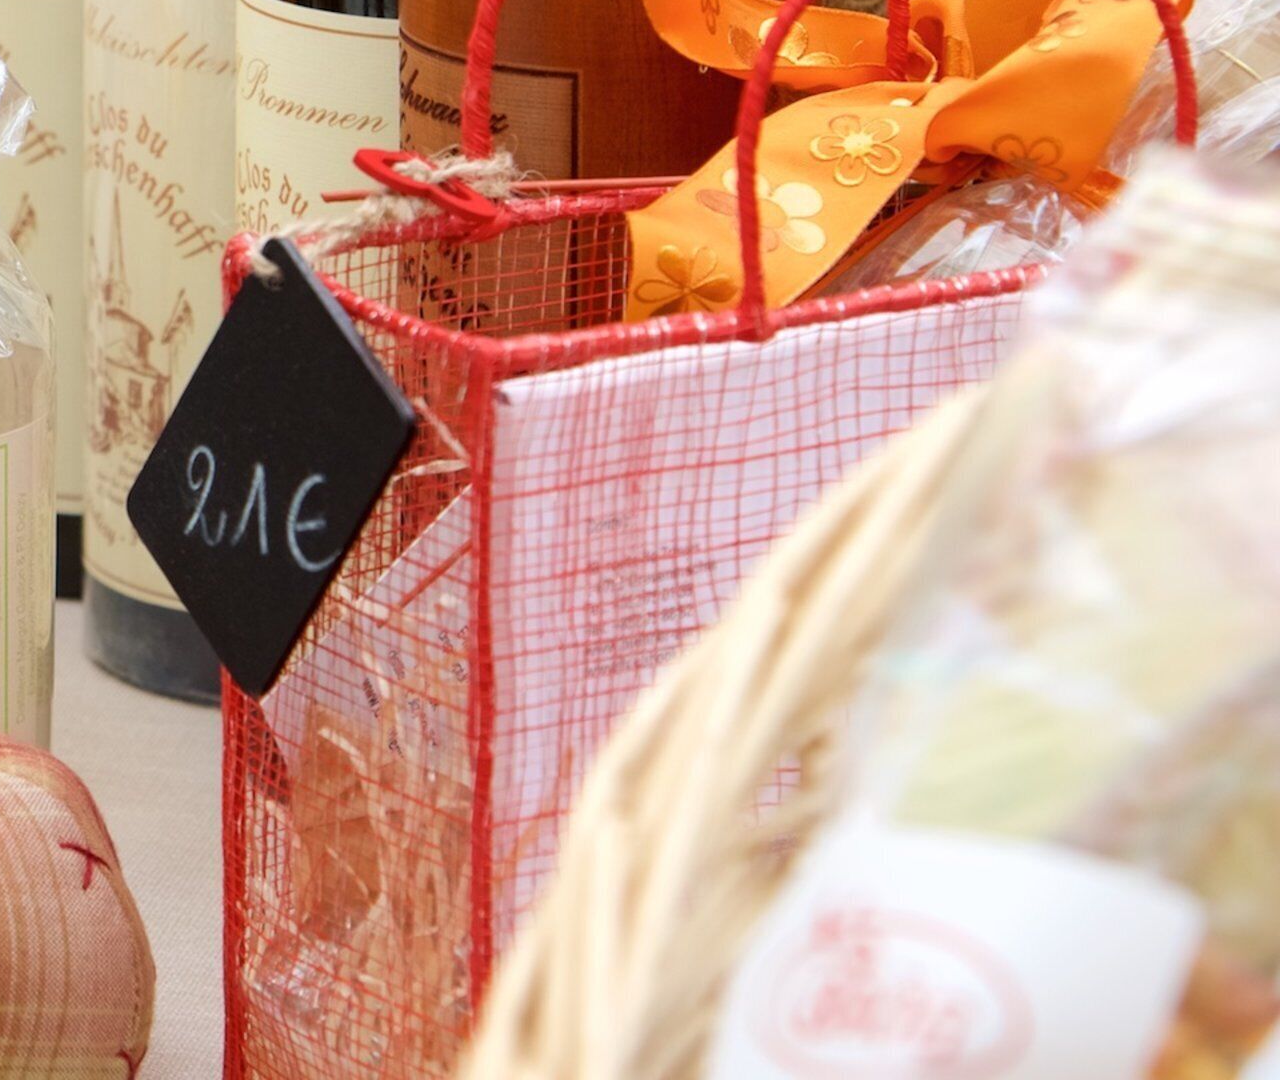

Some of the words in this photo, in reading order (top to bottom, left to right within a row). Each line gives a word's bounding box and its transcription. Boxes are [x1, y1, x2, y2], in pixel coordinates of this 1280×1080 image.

[246, 58, 389, 133] Prommen
[136, 114, 168, 159] du
[279, 173, 308, 217] du
[184, 446, 339, 572] 21€
